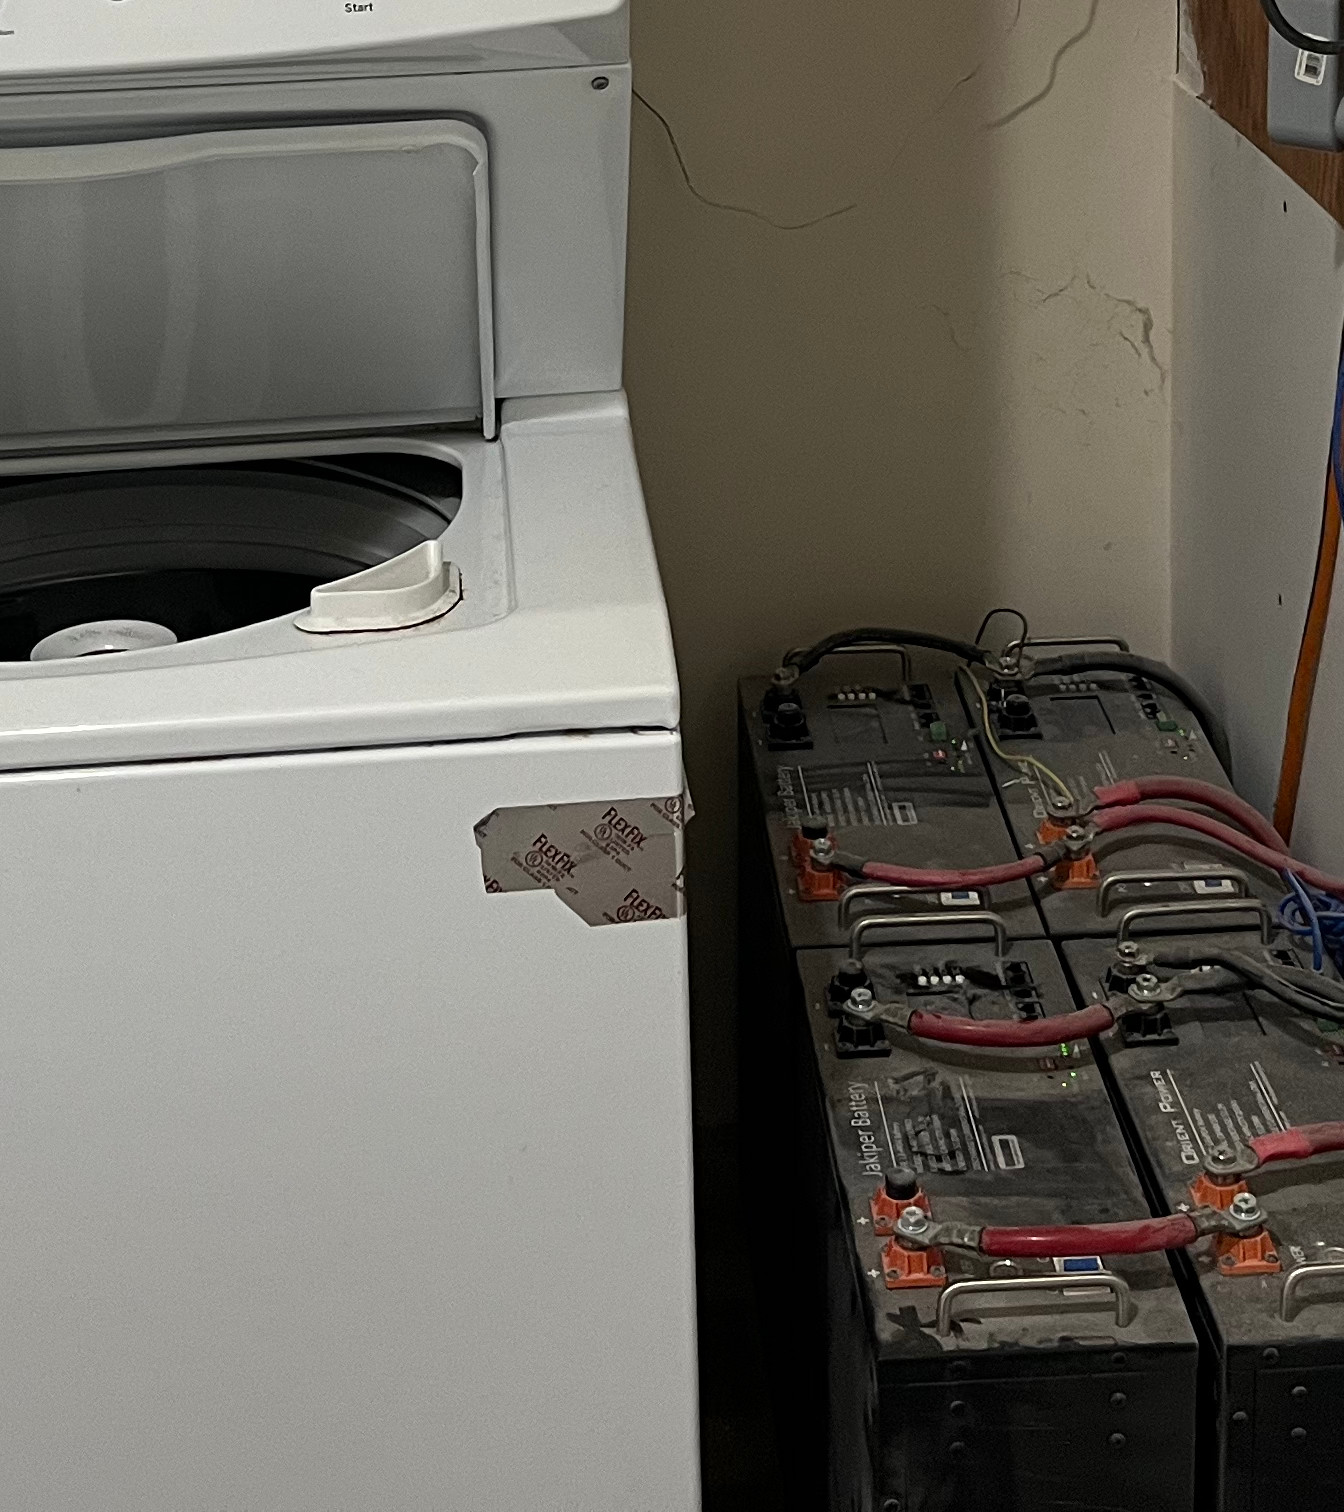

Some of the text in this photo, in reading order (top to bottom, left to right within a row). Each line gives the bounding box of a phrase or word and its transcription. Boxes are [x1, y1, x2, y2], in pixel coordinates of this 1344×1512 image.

[344, 2, 373, 13] Start
[602, 806, 648, 848] FLEXFIX
[533, 833, 577, 875] FLEXFIX
[848, 1081, 884, 1177] Jakiper Battery
